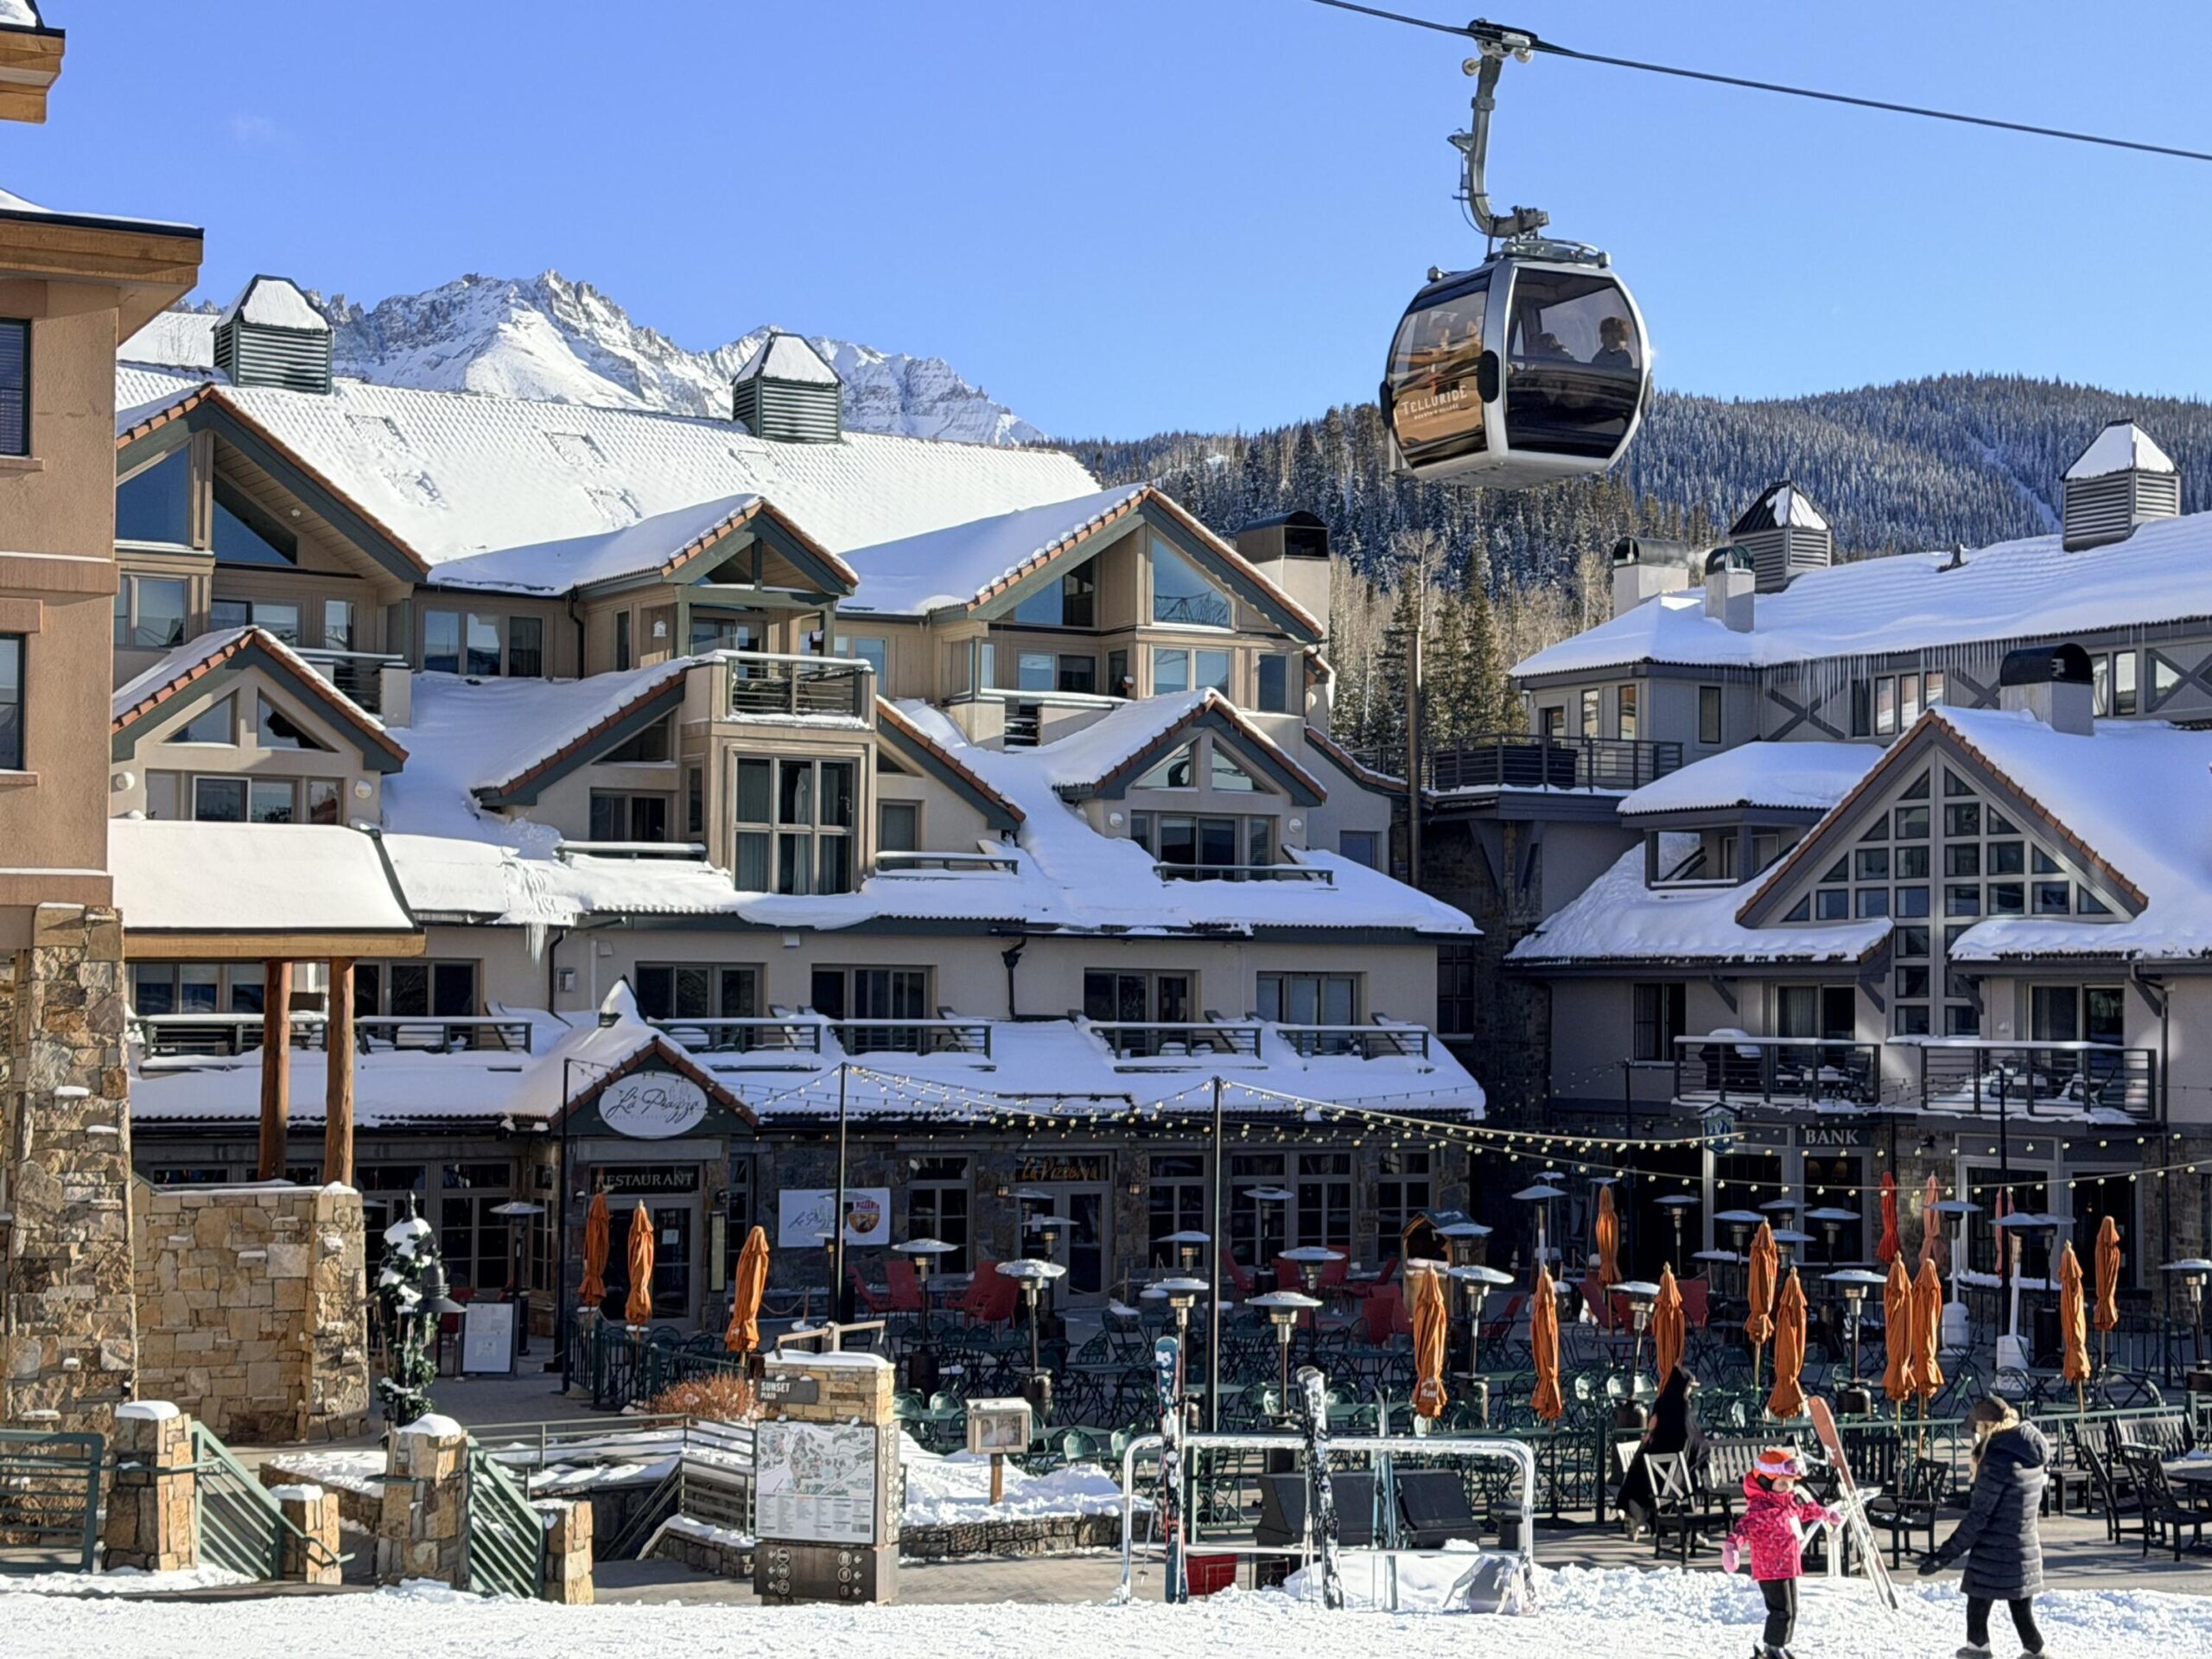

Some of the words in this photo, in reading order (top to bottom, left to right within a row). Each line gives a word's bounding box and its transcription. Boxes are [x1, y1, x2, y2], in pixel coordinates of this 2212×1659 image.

[1401, 385, 1468, 415] TELLURIDE
[1805, 1128, 1859, 1145] BANK
[760, 1381, 791, 1393] SUNSET
